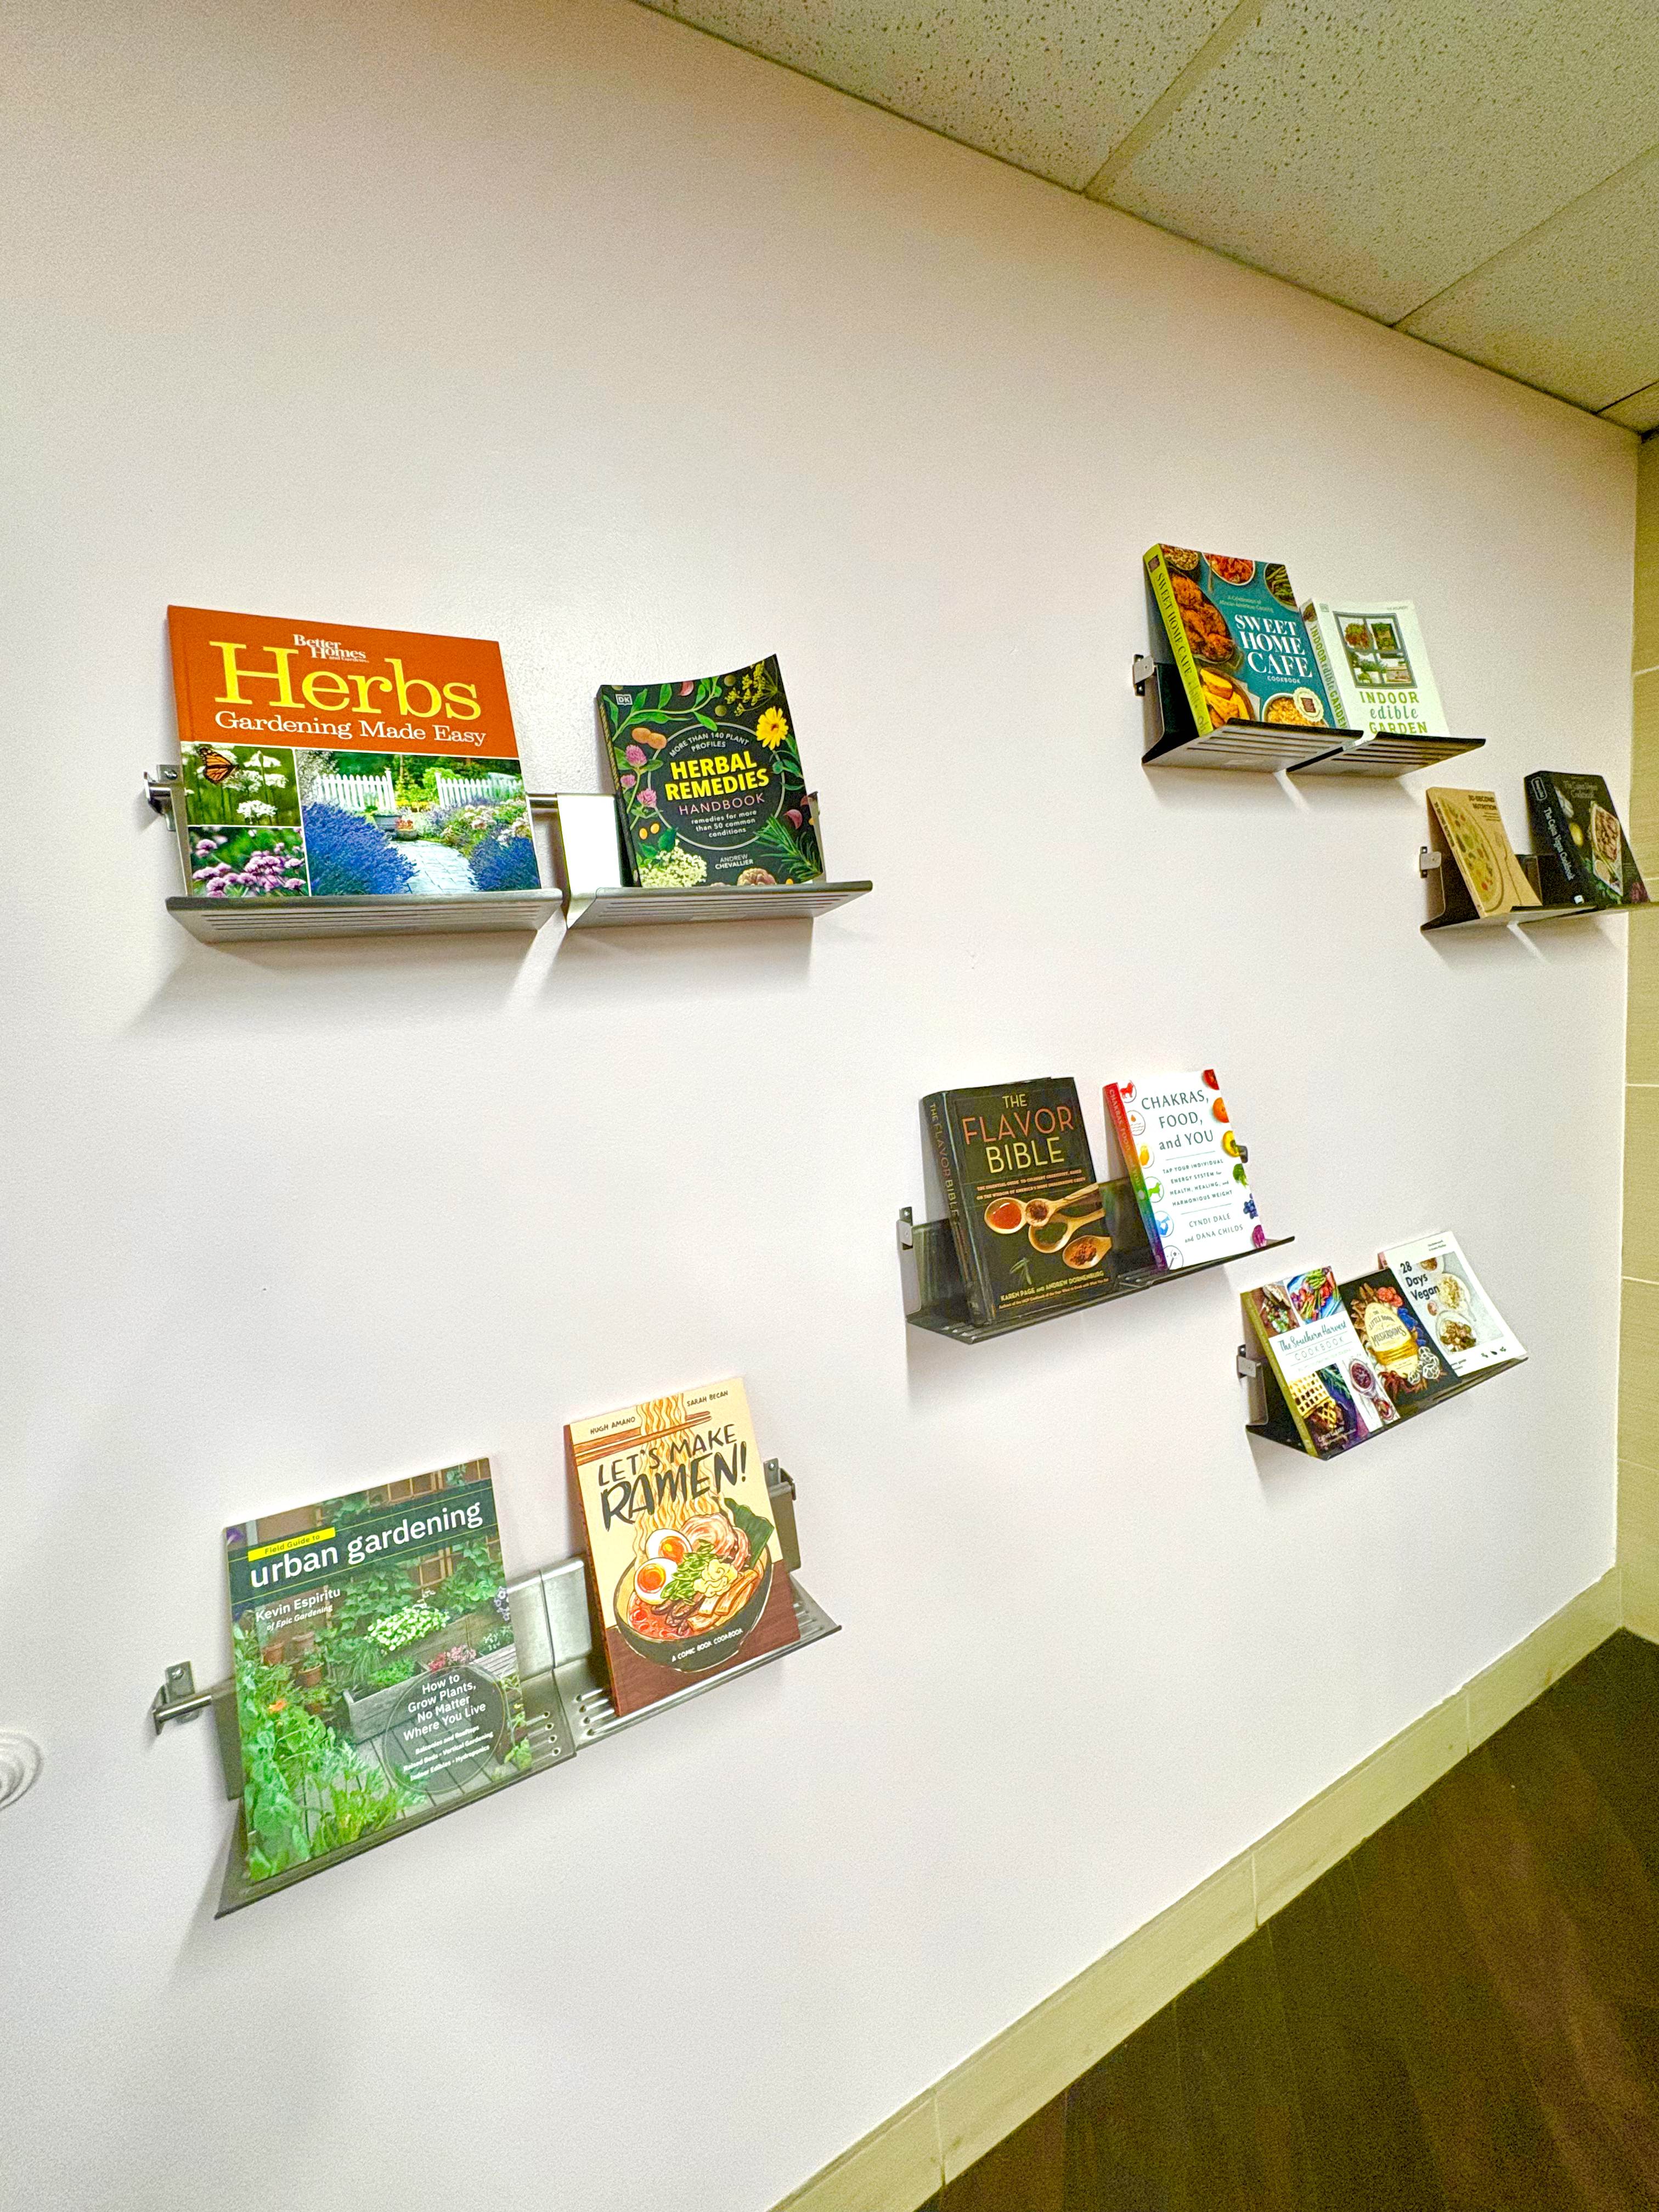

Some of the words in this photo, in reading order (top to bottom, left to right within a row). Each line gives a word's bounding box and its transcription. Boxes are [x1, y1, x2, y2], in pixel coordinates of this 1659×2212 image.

[1156, 572, 1172, 614] SWEET
[1167, 610, 1183, 647] HOME
[1177, 646, 1193, 678] CAFE
[1234, 614, 1296, 635] SWEET
[293, 634, 341, 650] Better
[1239, 631, 1305, 655] HOME
[1310, 625, 1327, 664] INDOOR
[311, 647, 366, 659] Homes
[1248, 651, 1312, 678] CAFE
[209, 640, 481, 721] Herbs
[1267, 675, 1301, 684] COOKBOOK
[618, 696, 630, 704] DK
[1359, 691, 1419, 704] INDOOR
[1370, 706, 1419, 719] edible
[215, 710, 352, 739] Gardening
[359, 720, 426, 740] Made
[433, 724, 486, 746] Easy
[1369, 721, 1428, 733] GARDEN
[669, 740, 688, 757] MORE
[688, 733, 708, 743] THAN
[725, 733, 749, 746] PLANT
[691, 741, 726, 752] PROFILES
[670, 751, 757, 780] HERBAL
[665, 768, 769, 800] REMEDIES
[679, 792, 765, 815] HANDBOOK
[1544, 807, 1553, 820] The
[691, 816, 724, 825] remedies
[738, 810, 757, 818] more
[725, 818, 755, 828] common
[708, 827, 747, 838] conditions
[715, 859, 753, 870] CHEVALLIER
[720, 854, 748, 863] ANDREW
[1002, 1093, 1028, 1108] THE
[1142, 1090, 1209, 1110] CHAKRAS,
[962, 1106, 1074, 1145] FLAVOR
[1159, 1111, 1203, 1128] FOOD,
[930, 1102, 938, 1121] THE
[934, 1123, 951, 1180] FLAVOR
[1159, 1135, 1182, 1150] and
[1184, 1130, 1213, 1145] YOU
[985, 1137, 1064, 1173] BIBLE
[1191, 1159, 1223, 1169] INDIVIDUAL
[1170, 1187, 1193, 1195] HEALTH,
[1195, 1182, 1221, 1190] HEALING,
[1171, 1176, 1192, 1184] ENERGY
[1172, 1194, 1210, 1206] HARMONIOUS
[1211, 1190, 1232, 1198] WEIGHT
[1189, 1217, 1211, 1228] CYNDI
[1214, 1213, 1231, 1222] DALE
[1196, 1231, 1216, 1240] DANA
[1218, 1224, 1243, 1235] CHILDS
[1400, 1261, 1412, 1273] 28
[1000, 1291, 1020, 1301] KAREN
[1020, 1288, 1035, 1297] PAGE
[1045, 1279, 1068, 1290] ANDREW
[1406, 1274, 1428, 1287] Days
[1410, 1285, 1440, 1301] Vegan
[1278, 1339, 1291, 1352] The
[1290, 1331, 1323, 1348] Southern
[1321, 1321, 1347, 1335] Harvest
[1294, 1336, 1344, 1361] COOKBOOK
[687, 1397, 707, 1407] SARAH
[709, 1390, 729, 1400] BECAN
[590, 1424, 608, 1435] HUGH
[611, 1417, 635, 1429] AMANO
[599, 1447, 660, 1486] LET'S
[670, 1424, 737, 1463] MAKE
[600, 1441, 747, 1532] RAMEN!
[250, 1545, 338, 1588] urban
[347, 1502, 484, 1565] gardening
[264, 1545, 285, 1555] Field
[287, 1539, 311, 1549] Guide
[255, 1604, 290, 1623] Kevin
[294, 1587, 341, 1612] Espiritu
[267, 1620, 276, 1631] of
[276, 1616, 293, 1630] Epic
[293, 1604, 332, 1622] Gardening
[678, 1647, 696, 1659] COMIC
[697, 1641, 713, 1651] BOOK
[713, 1628, 743, 1644] COOKBOOK
[422, 1678, 446, 1694] How
[449, 1674, 460, 1684] to
[408, 1696, 437, 1713] Grow
[439, 1682, 476, 1701] Plants,
[417, 1711, 432, 1723] No
[435, 1696, 470, 1716] Matter
[403, 1721, 439, 1741] Where
[442, 1712, 462, 1726] You
[465, 1703, 486, 1718] Live
[415, 1739, 443, 1754] Balconies
[443, 1734, 454, 1743] and
[442, 1742, 465, 1756] Vertical
[465, 1731, 493, 1747] Gardening
[430, 1760, 451, 1773] Edibles
[455, 1745, 490, 1763] Hydroponics
